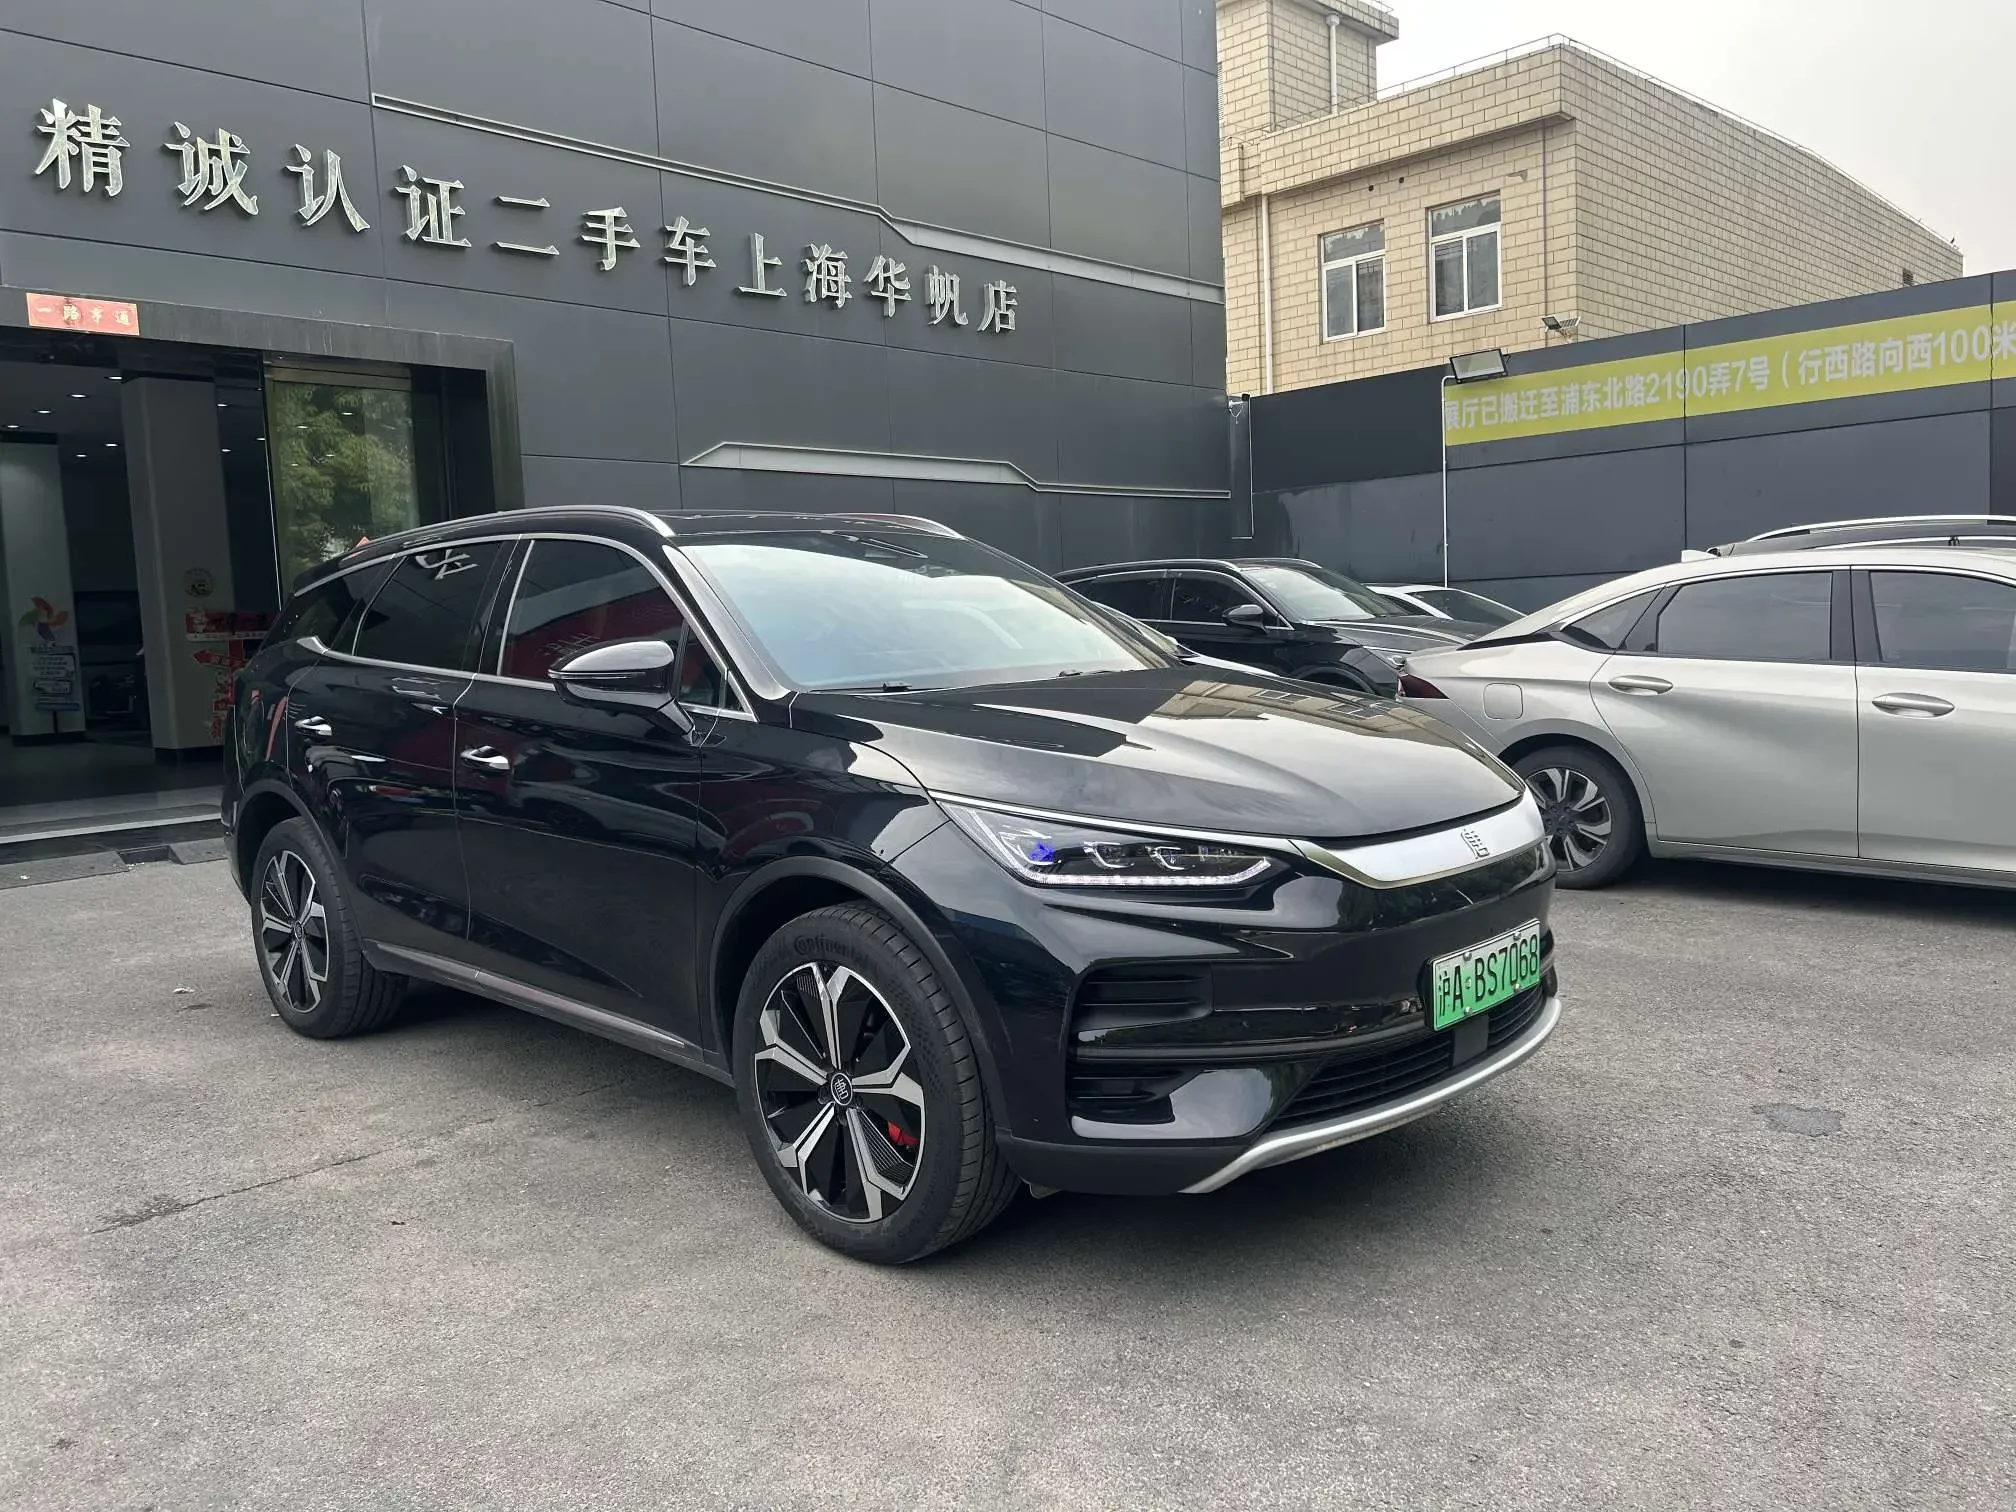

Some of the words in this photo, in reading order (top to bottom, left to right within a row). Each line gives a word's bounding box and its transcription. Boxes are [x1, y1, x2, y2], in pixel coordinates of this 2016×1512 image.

[34, 97, 1019, 334] 精诚认证二手车上海华帆店
